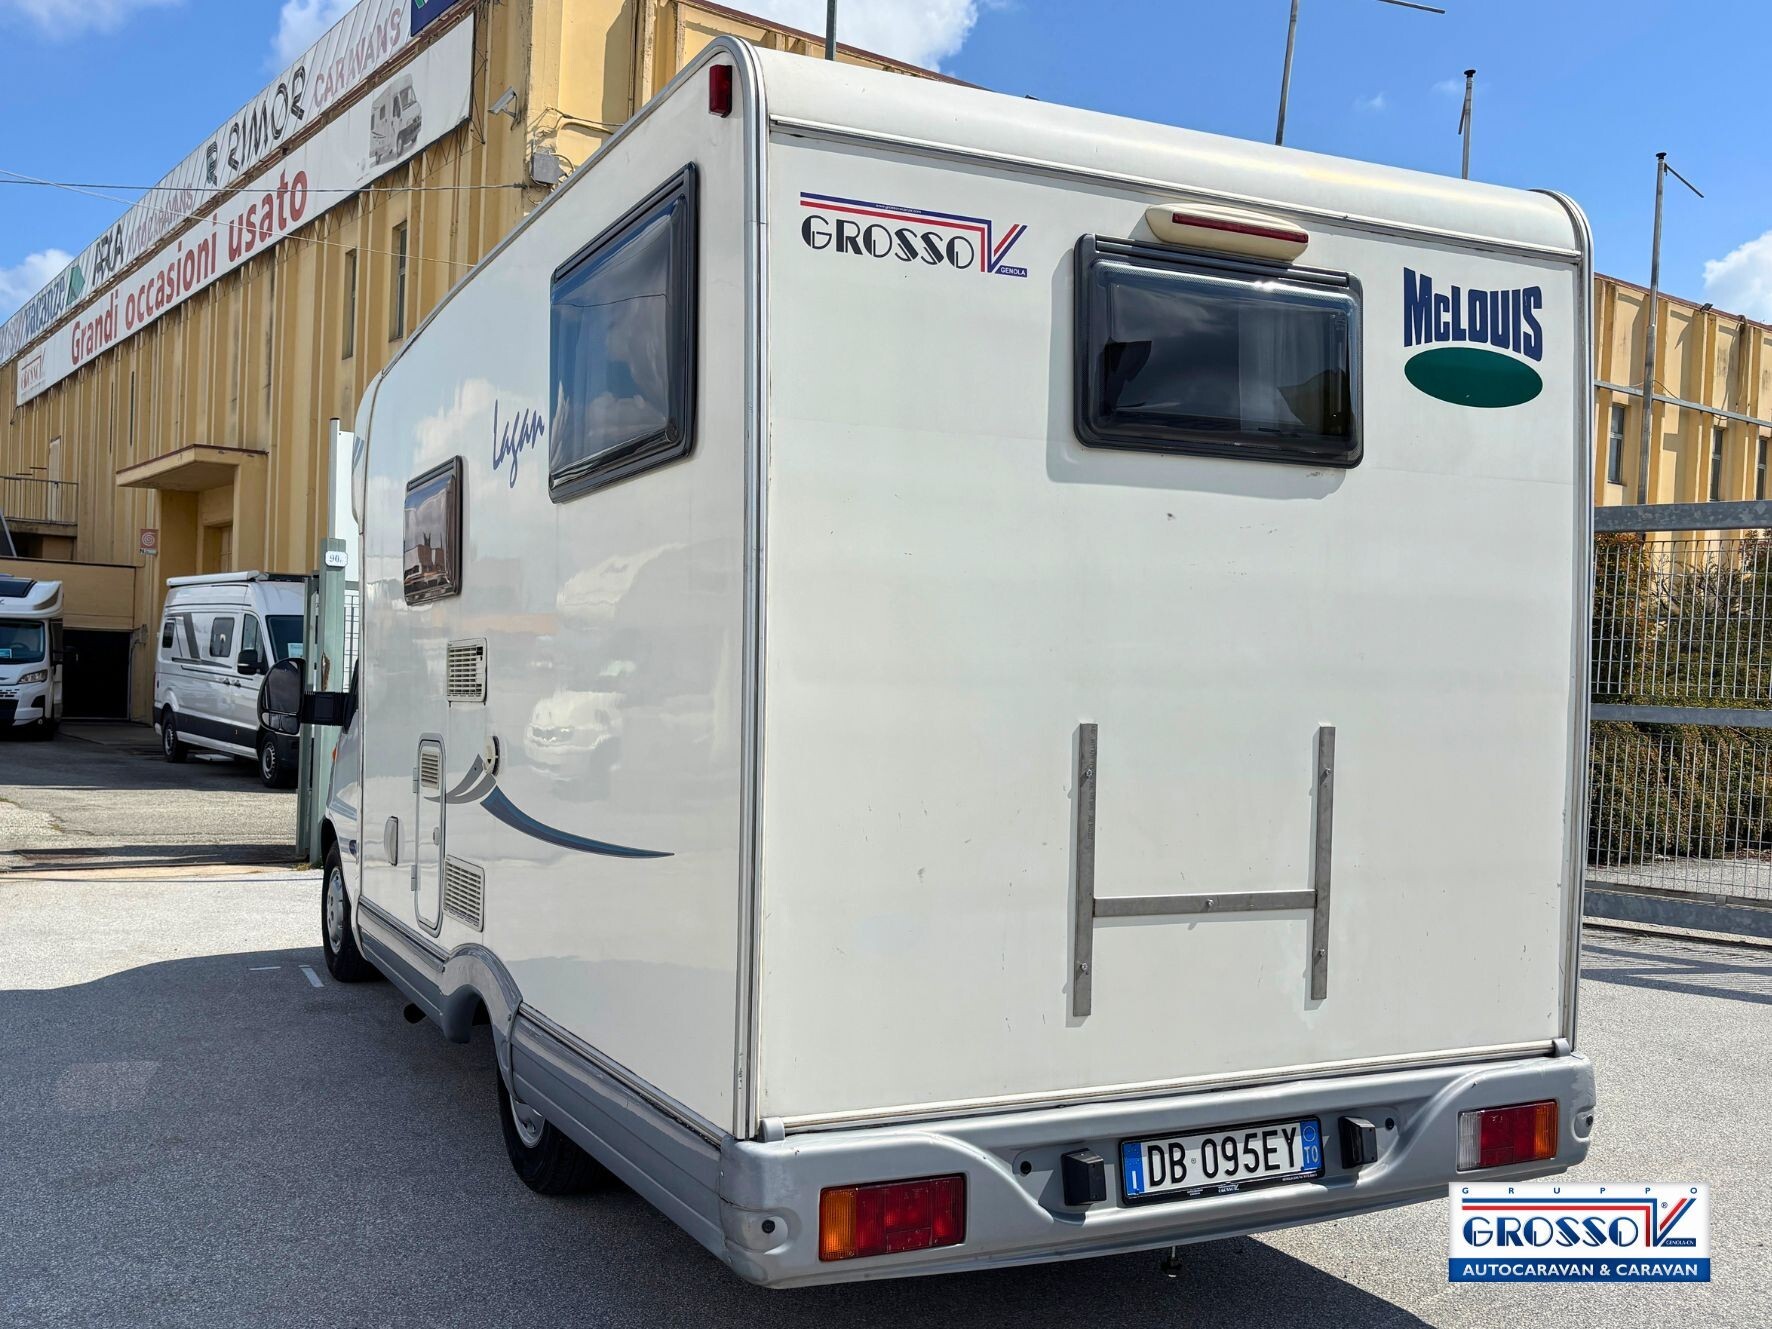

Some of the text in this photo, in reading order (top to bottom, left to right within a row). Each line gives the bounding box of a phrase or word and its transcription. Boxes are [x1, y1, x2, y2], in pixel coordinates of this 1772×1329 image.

[227, 65, 306, 172] RIMOR
[313, 7, 401, 109] CARAVANS
[71, 288, 119, 365] Grandi
[125, 212, 218, 331] occasioni
[228, 168, 308, 263] usato
[801, 214, 975, 270] GROSSO
[1000, 266, 1027, 276] GENOLA
[1403, 266, 1544, 362] McLOUIS
[492, 398, 546, 489] Lagan
[1147, 1141, 1188, 1188] DB
[1200, 1126, 1298, 1180] 095EY
[1303, 1145, 1320, 1165] TO
